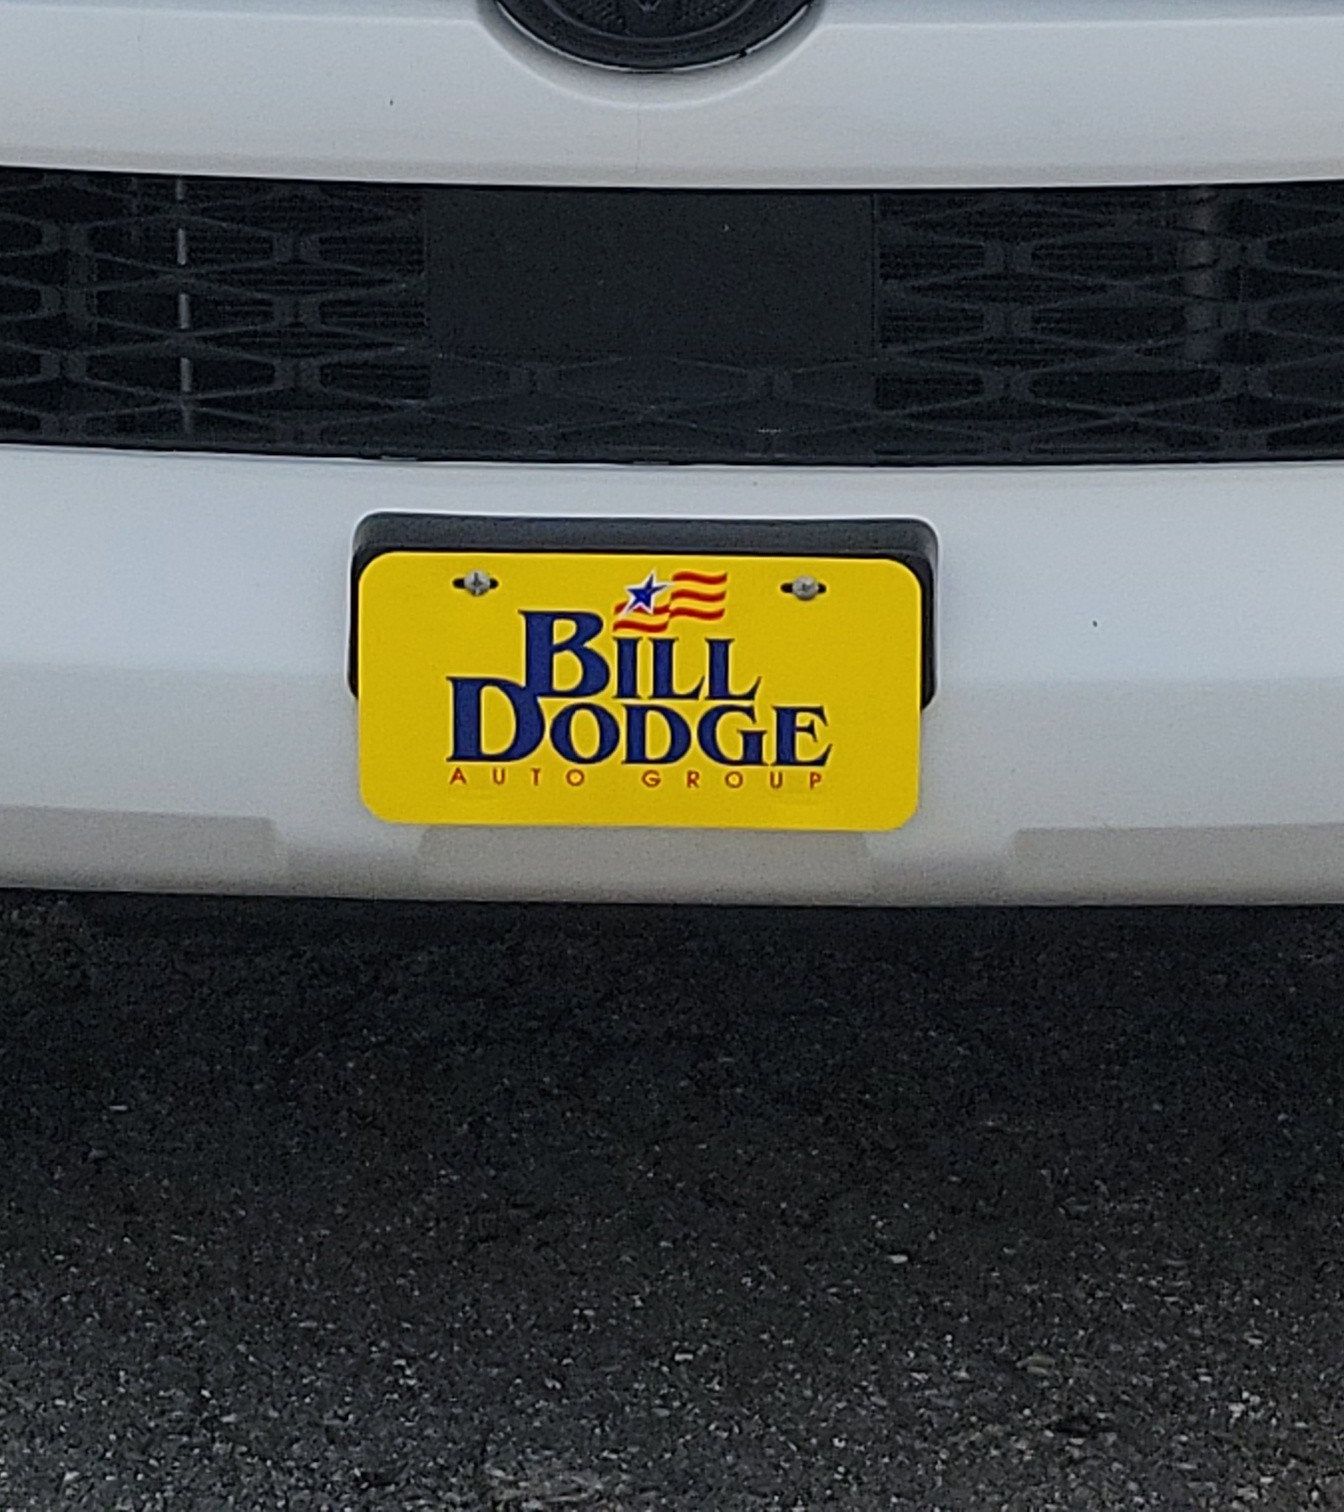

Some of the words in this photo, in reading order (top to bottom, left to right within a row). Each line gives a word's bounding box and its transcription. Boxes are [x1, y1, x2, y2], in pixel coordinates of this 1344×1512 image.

[519, 610, 762, 700] BILL
[446, 676, 832, 766] DODGE
[448, 768, 586, 787] AUTO
[641, 770, 822, 789] GROUP
